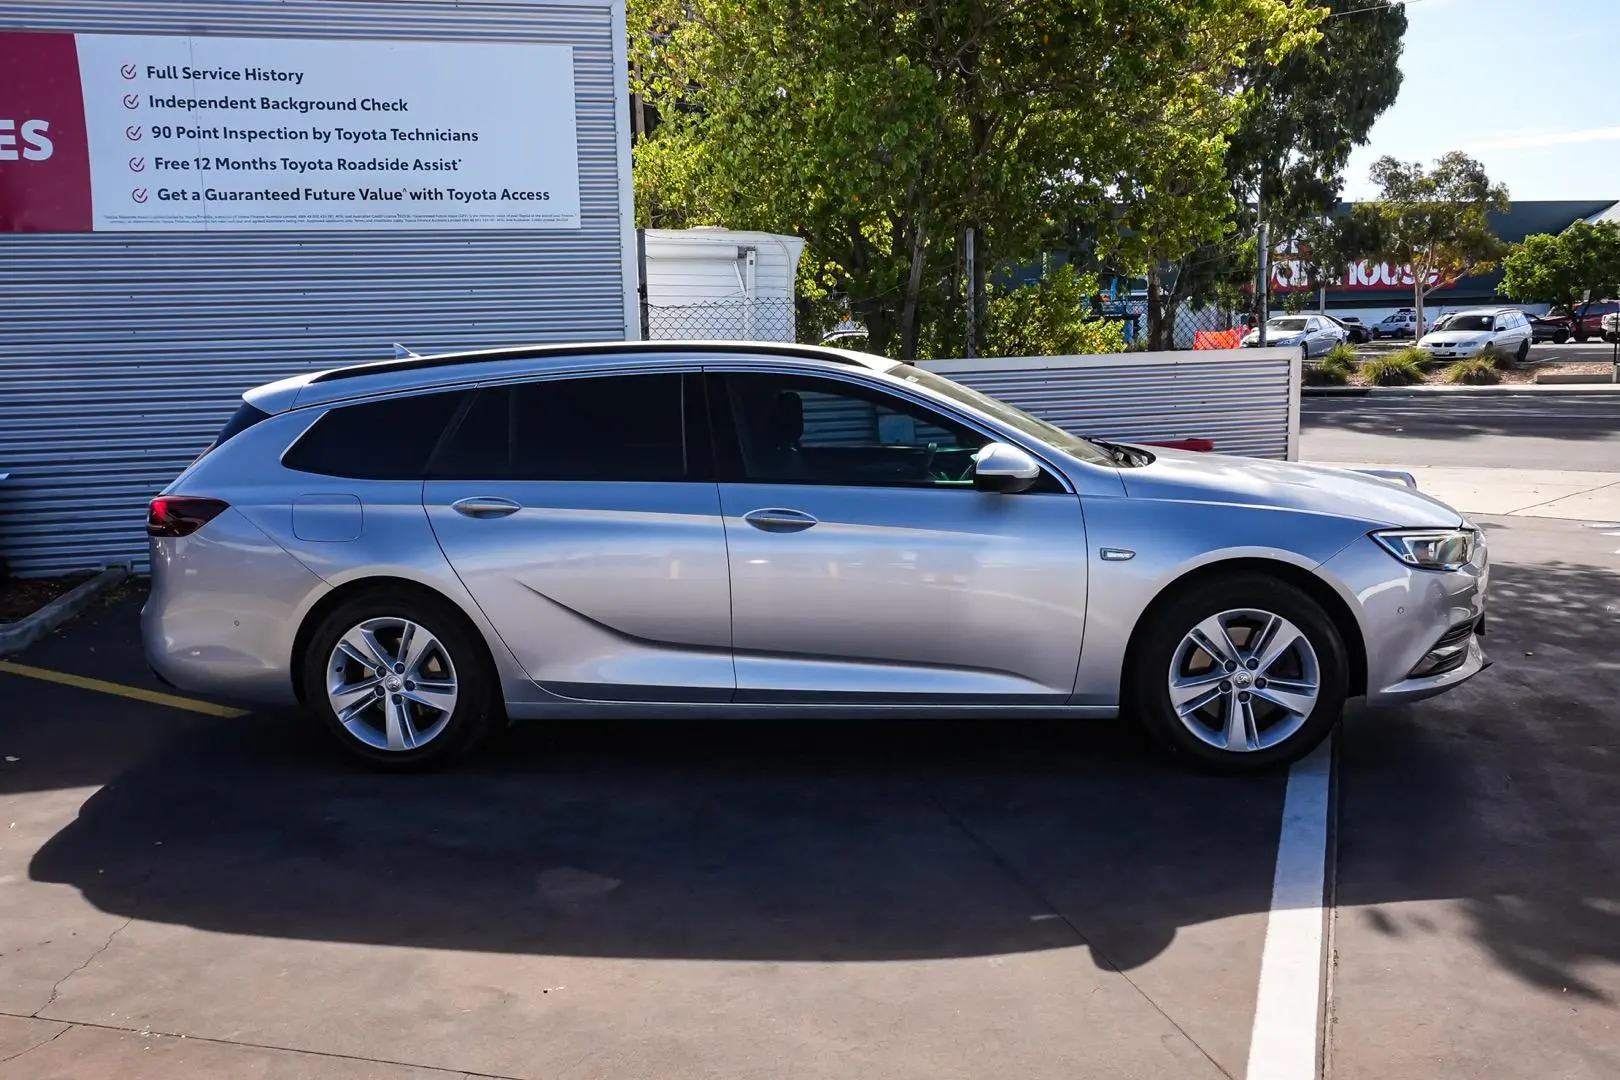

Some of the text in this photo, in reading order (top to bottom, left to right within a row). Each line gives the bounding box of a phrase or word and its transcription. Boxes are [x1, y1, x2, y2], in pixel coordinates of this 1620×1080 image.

[146, 65, 304, 85] Full Service History
[149, 94, 409, 114] Independent Background Check
[151, 125, 479, 144] 90 Point Inspection by Toyota Technicians
[154, 157, 190, 170] Free
[193, 157, 212, 171] 12
[215, 156, 277, 171] Months
[279, 157, 333, 174] Toyota
[337, 157, 409, 171] Roadside
[157, 188, 188, 201] Get
[191, 191, 201, 201] a
[204, 187, 301, 201] Guaranteed
[304, 188, 356, 201] Future
[409, 187, 444, 201] with
[446, 188, 497, 204] Toyota
[500, 188, 550, 201] Access
